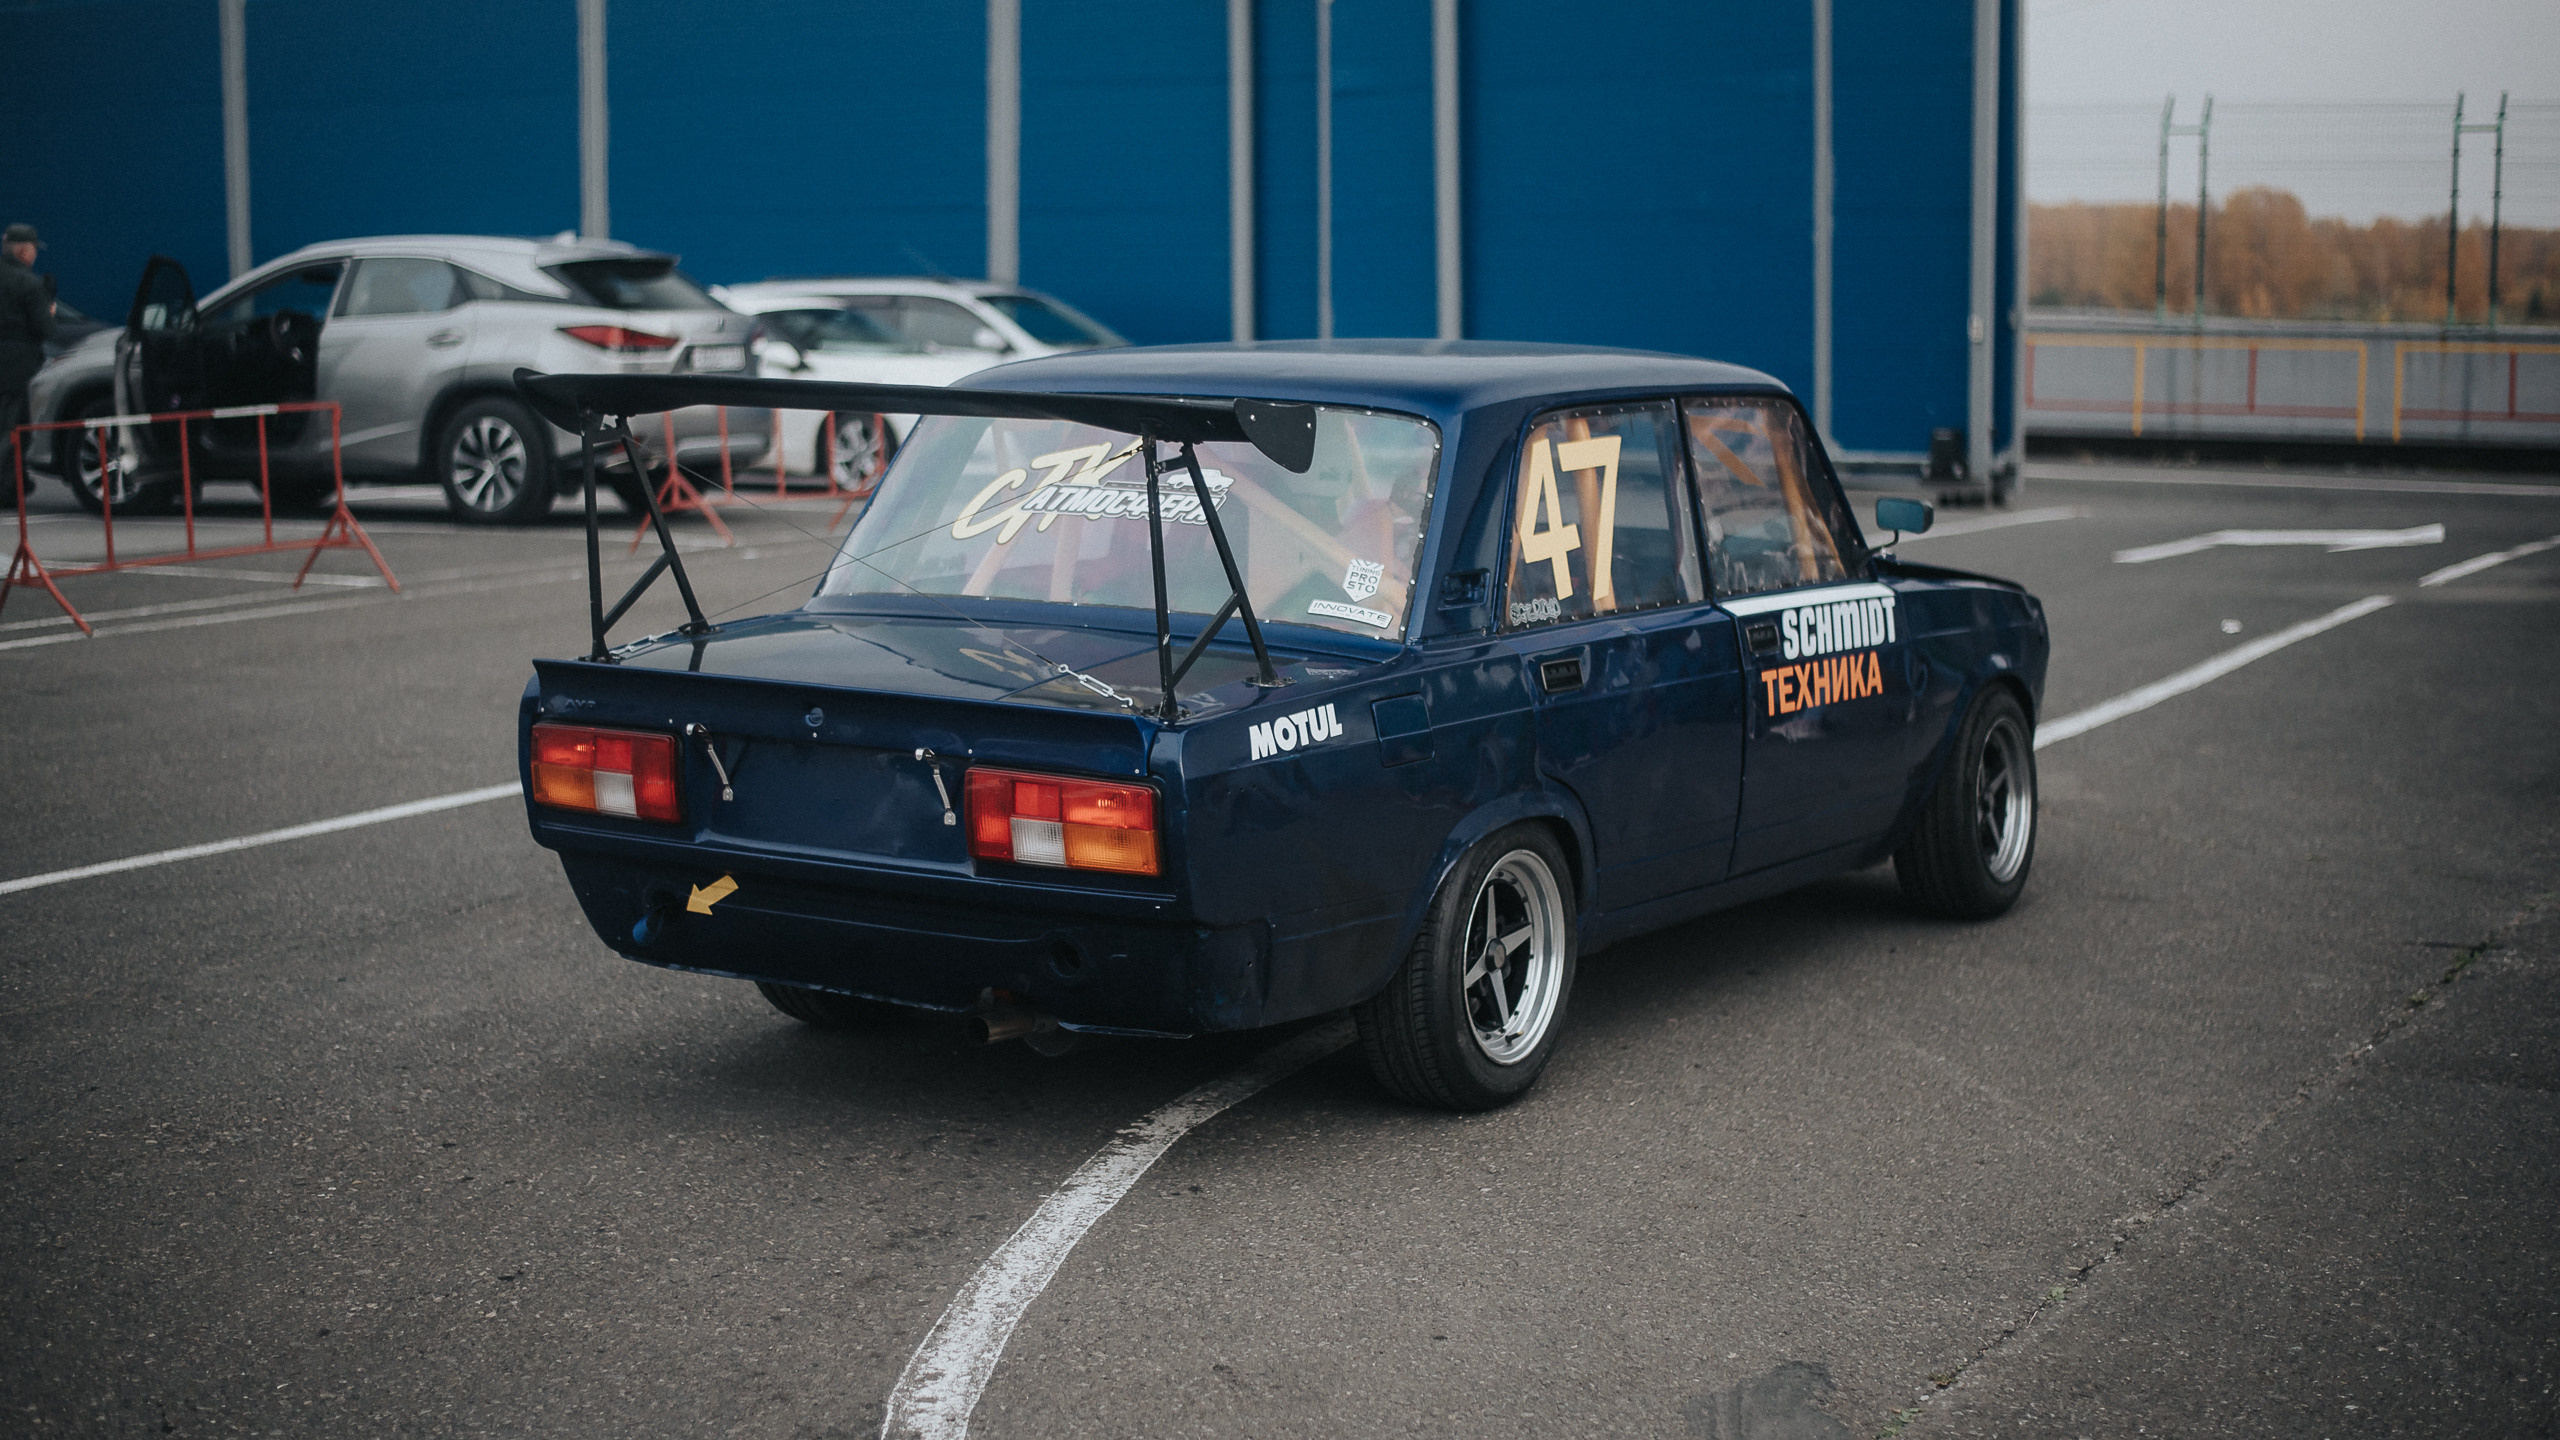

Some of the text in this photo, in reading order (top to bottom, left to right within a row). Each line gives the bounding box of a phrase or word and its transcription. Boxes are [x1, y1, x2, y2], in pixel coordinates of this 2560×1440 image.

[1520, 435, 1622, 601] 47
[1346, 581, 1376, 594] STO
[1349, 571, 1378, 585] PRO
[1352, 565, 1381, 576] TUNING
[1313, 602, 1388, 622] INNOVATE
[1781, 597, 1896, 660] SCHMIDT
[1761, 651, 1883, 716] ТЕХНИКА
[1248, 703, 1343, 761] MOTUL
